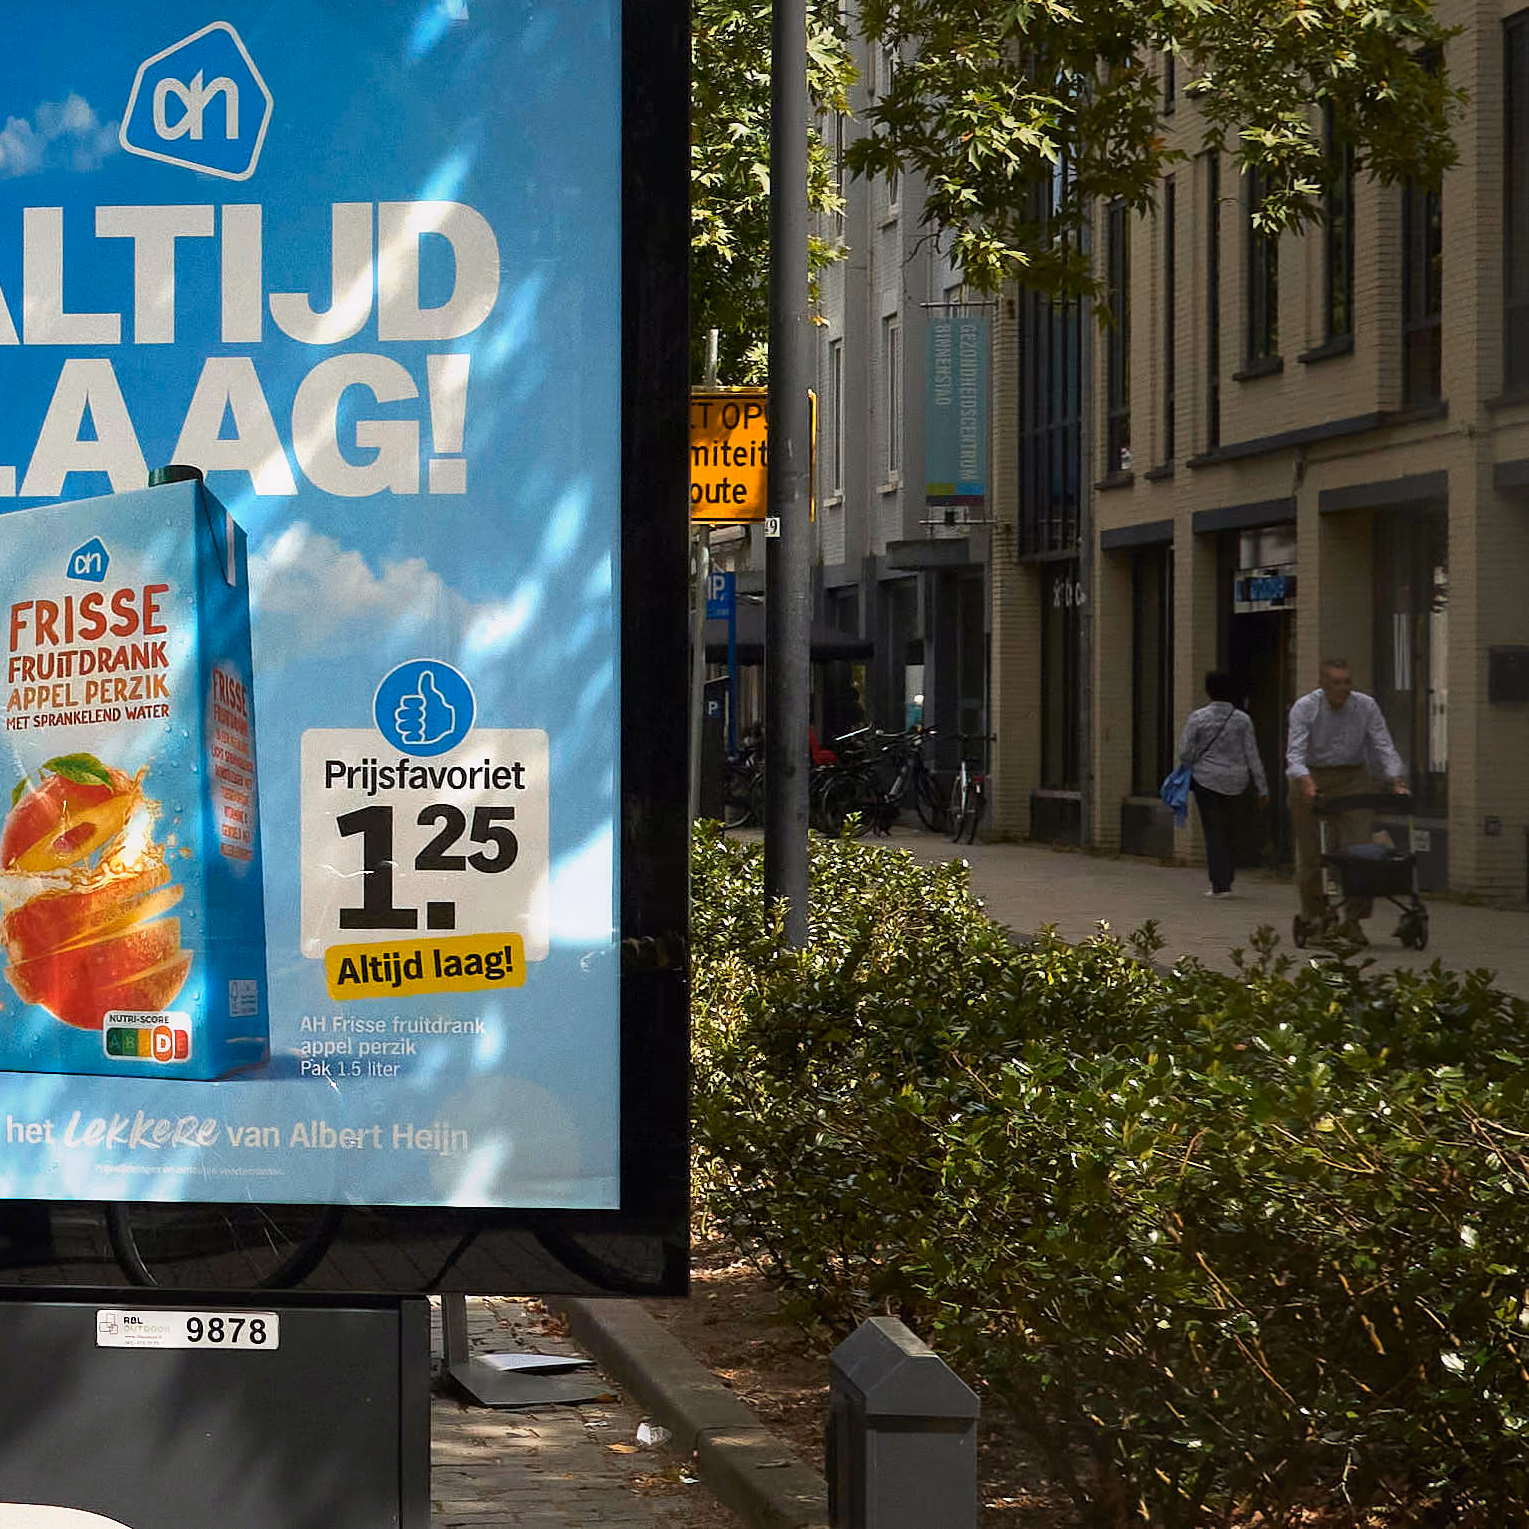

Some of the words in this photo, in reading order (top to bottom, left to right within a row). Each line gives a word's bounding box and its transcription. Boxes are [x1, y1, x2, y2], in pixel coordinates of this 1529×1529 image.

[691, 439, 767, 468] miteit
[691, 476, 747, 505] oute
[9, 583, 170, 652] FRISSE
[7, 640, 170, 684] FRUITDRANK
[6, 682, 79, 712] APPEL
[85, 673, 170, 705] PERZIK
[6, 716, 31, 731] MET
[32, 706, 121, 728] SPRANKELEND
[125, 703, 170, 720] WATER
[324, 757, 526, 797] Prijsfavoriet
[337, 950, 423, 989] Altijd
[433, 945, 514, 981] laag!
[108, 1013, 170, 1024] NUTRI-SCORE
[300, 1015, 326, 1033] AH
[332, 1015, 386, 1034] Frisse
[392, 1015, 486, 1035] fruitdrank
[156, 1033, 172, 1053] D
[300, 1037, 352, 1059] appel
[358, 1037, 417, 1058] perzik
[300, 1060, 332, 1077] Pak
[337, 1061, 362, 1077] 1.5
[368, 1060, 401, 1078] liter
[6, 1114, 55, 1144] het
[227, 1124, 281, 1149] van
[290, 1121, 383, 1151] Albert
[391, 1121, 469, 1156] Heijn
[185, 1316, 268, 1345] 9878
